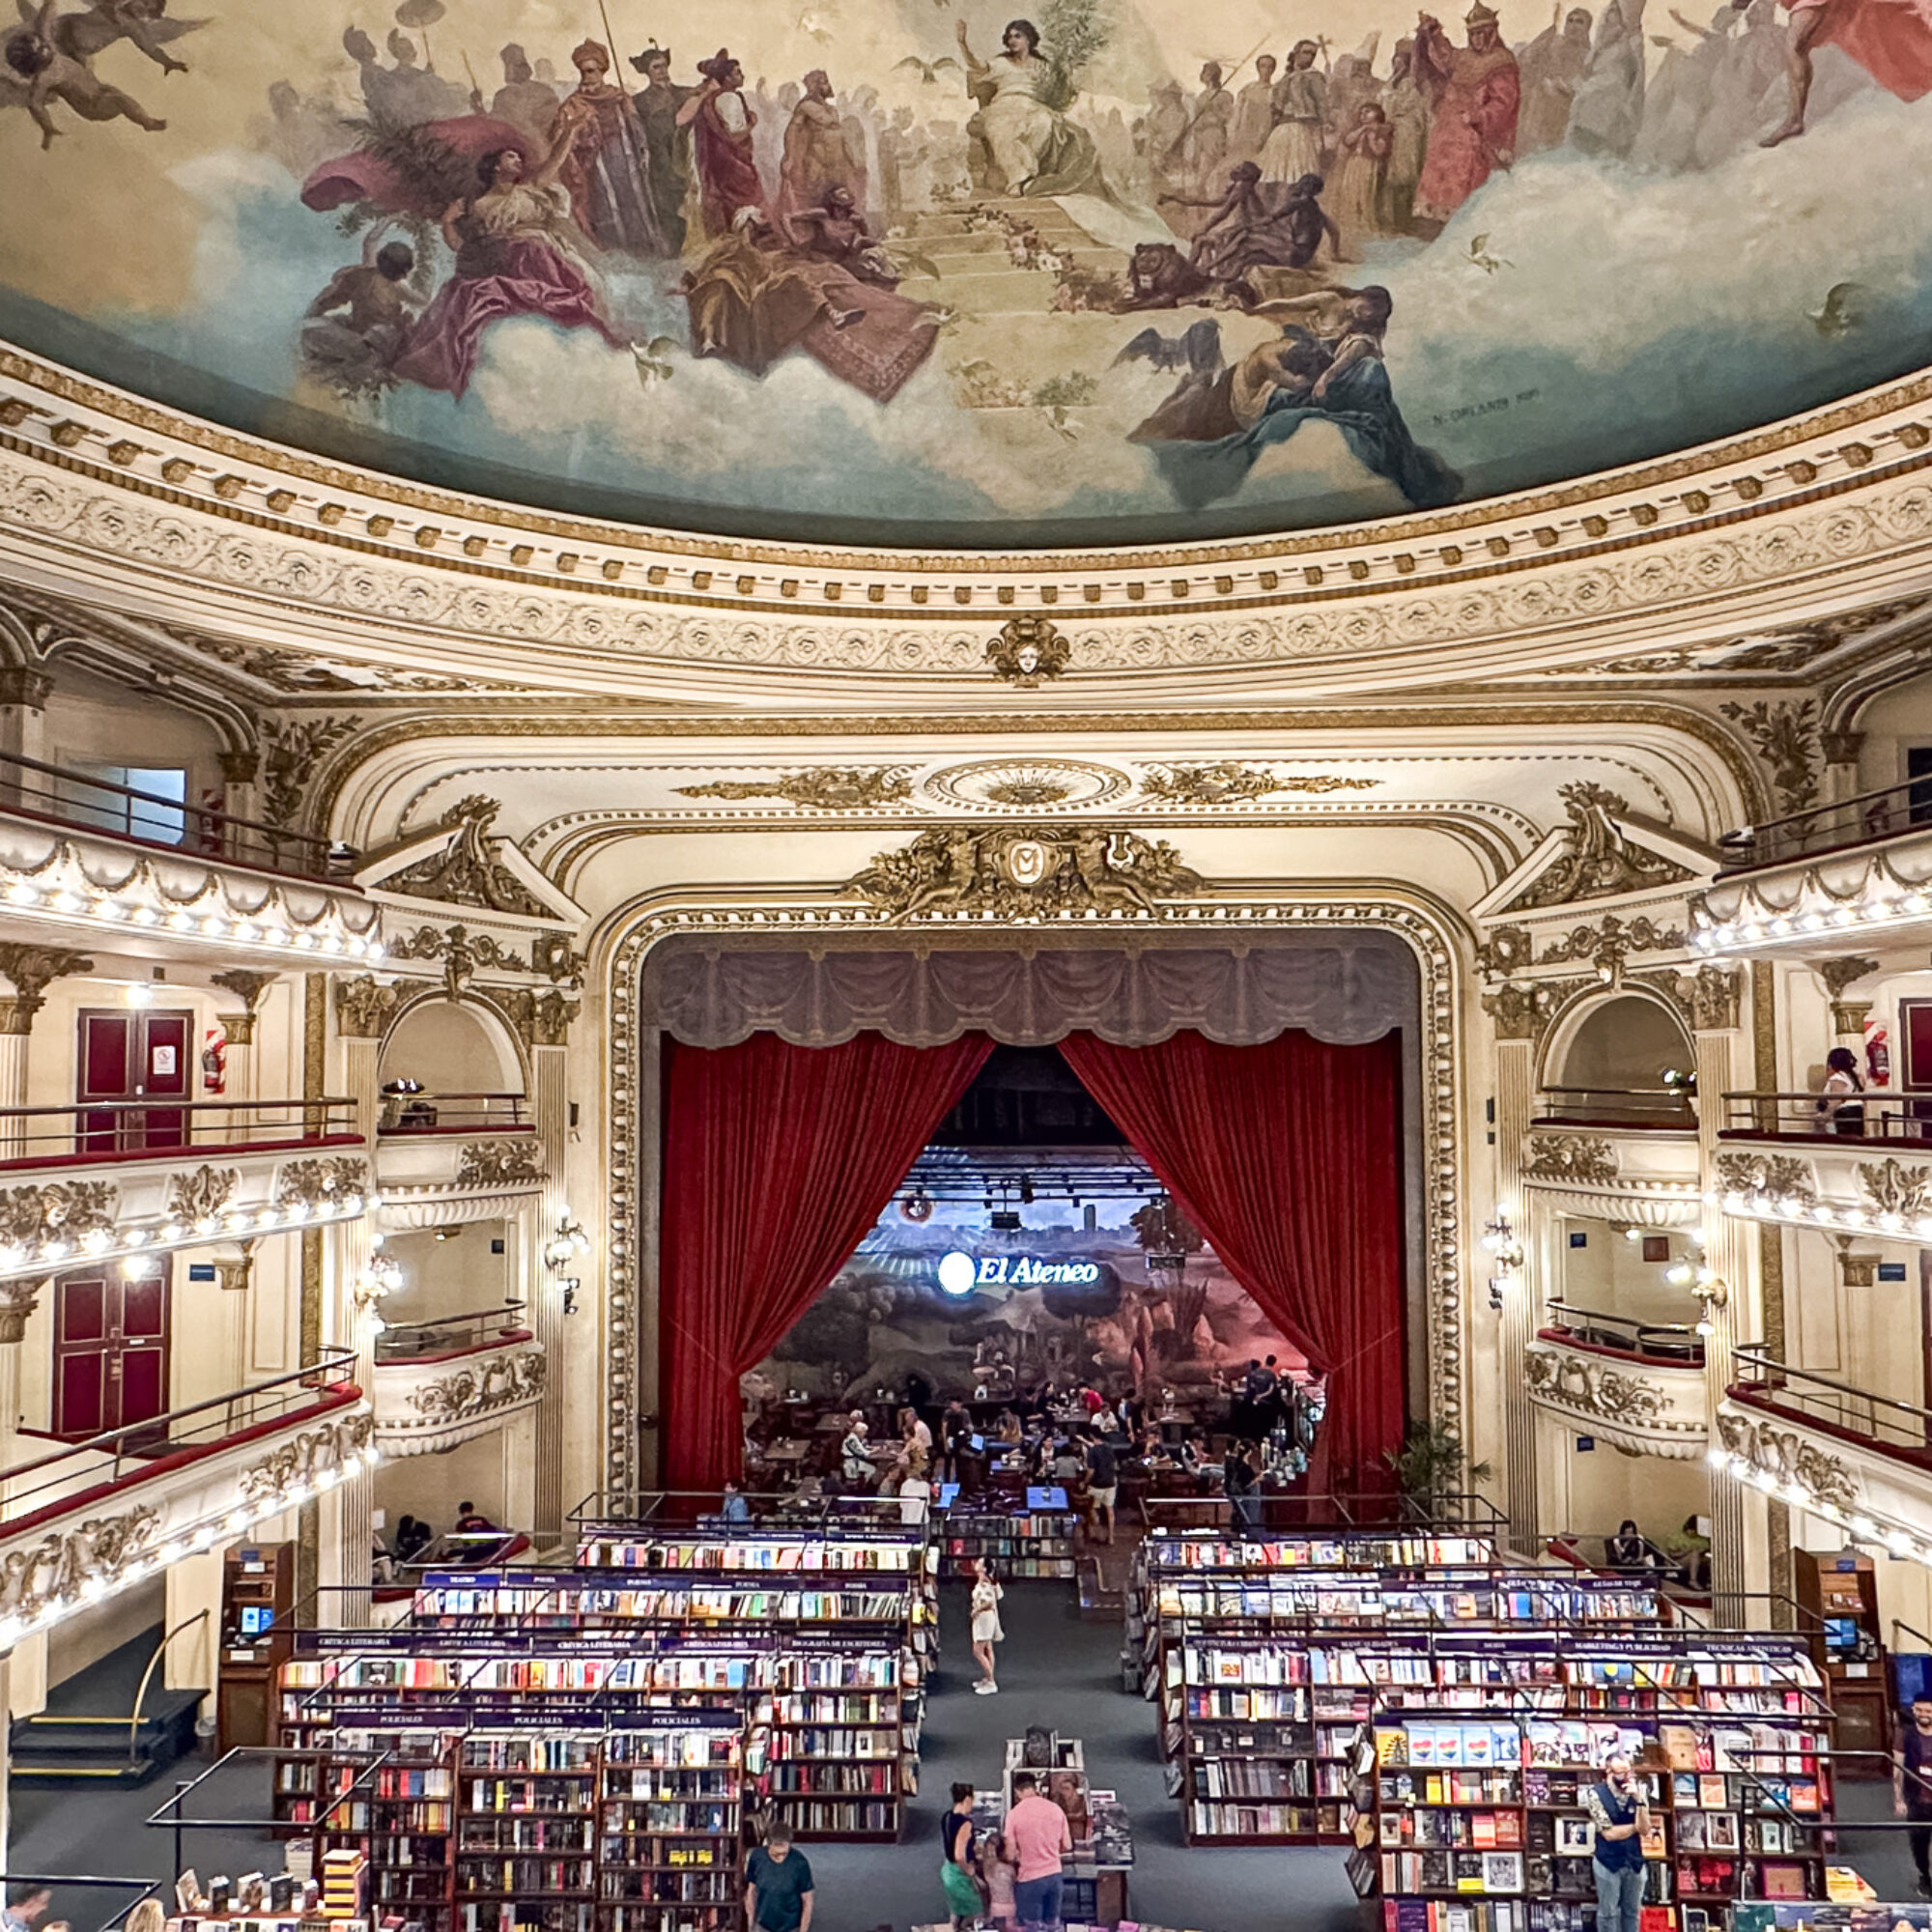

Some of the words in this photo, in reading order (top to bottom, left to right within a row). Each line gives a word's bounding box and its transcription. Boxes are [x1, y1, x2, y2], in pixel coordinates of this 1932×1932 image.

[977, 1257, 1009, 1284] El
[1009, 1256, 1099, 1284] Ateneo
[652, 1717, 701, 1725] POLICIALES
